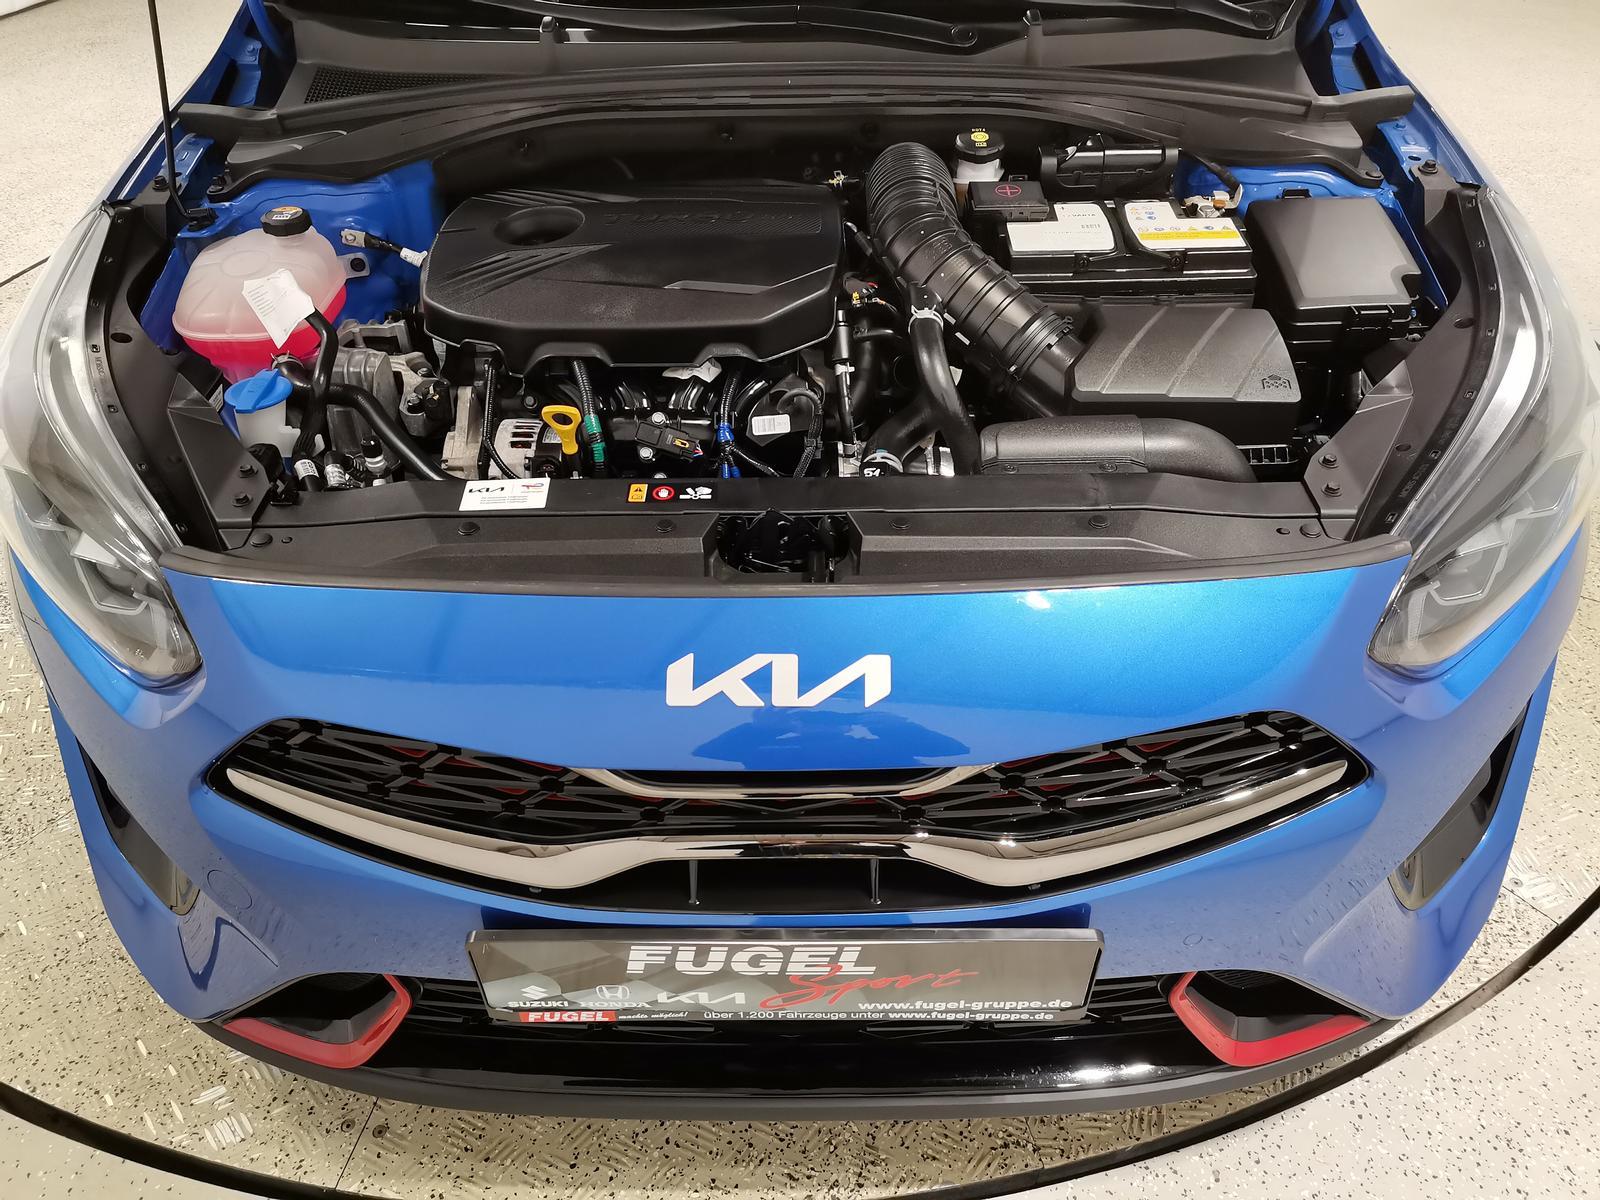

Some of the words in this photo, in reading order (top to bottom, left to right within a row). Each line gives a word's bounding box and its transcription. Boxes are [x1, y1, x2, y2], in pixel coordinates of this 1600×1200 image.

[666, 652, 892, 709] KIA
[626, 945, 876, 976] FUGEL
[760, 963, 979, 1009] Sport
[507, 1000, 569, 1008] SUZUKI
[657, 990, 746, 1005] KIA
[858, 1000, 1073, 1011] www.fugel-gruppe.de
[528, 1011, 609, 1023] FUGEL
[704, 1011, 734, 1019] über
[738, 1011, 774, 1019] 1.200
[778, 1011, 848, 1021] Fahrzeuge
[889, 1011, 1054, 1021] www.fugel-gruppe.de
